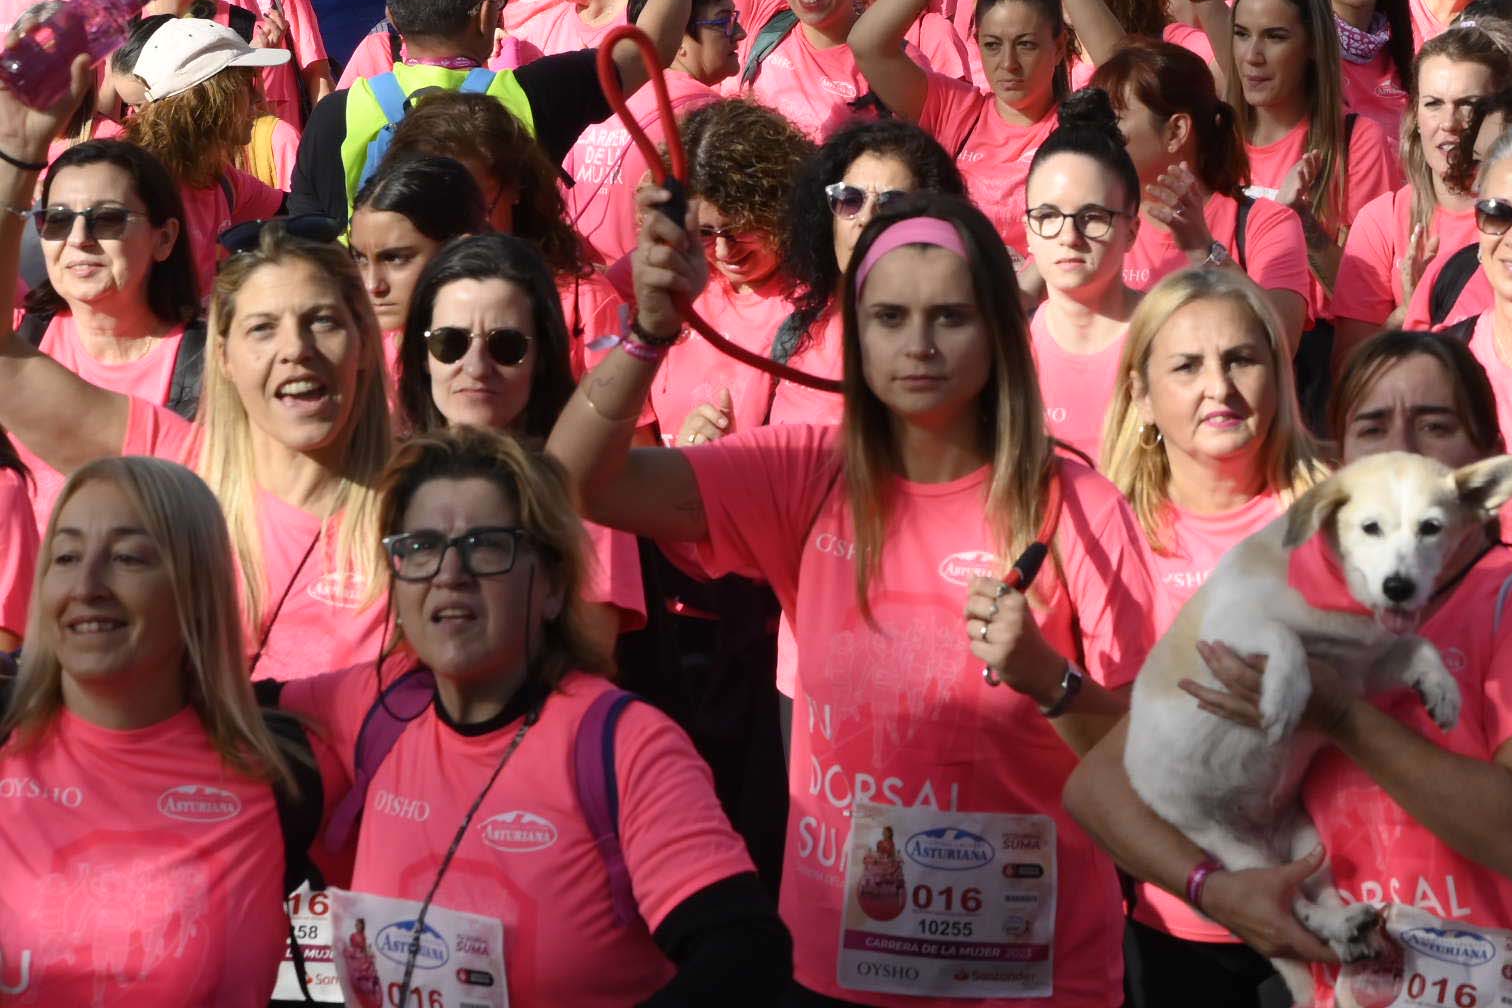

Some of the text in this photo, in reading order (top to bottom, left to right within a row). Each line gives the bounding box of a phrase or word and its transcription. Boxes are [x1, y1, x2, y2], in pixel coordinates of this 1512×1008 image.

[482, 820, 551, 843] ASTURIANA
[911, 841, 988, 862] ASTURIANA
[1002, 839, 1042, 851] SUMA
[288, 892, 330, 917] 16
[912, 885, 983, 912] 016
[918, 918, 973, 937] 10255
[865, 937, 919, 954] CARRERA
[922, 944, 939, 954] DE
[941, 946, 956, 955] LA
[959, 948, 1000, 958] MUJER
[857, 960, 919, 981] OYSHO
[1407, 972, 1478, 1008] 016
